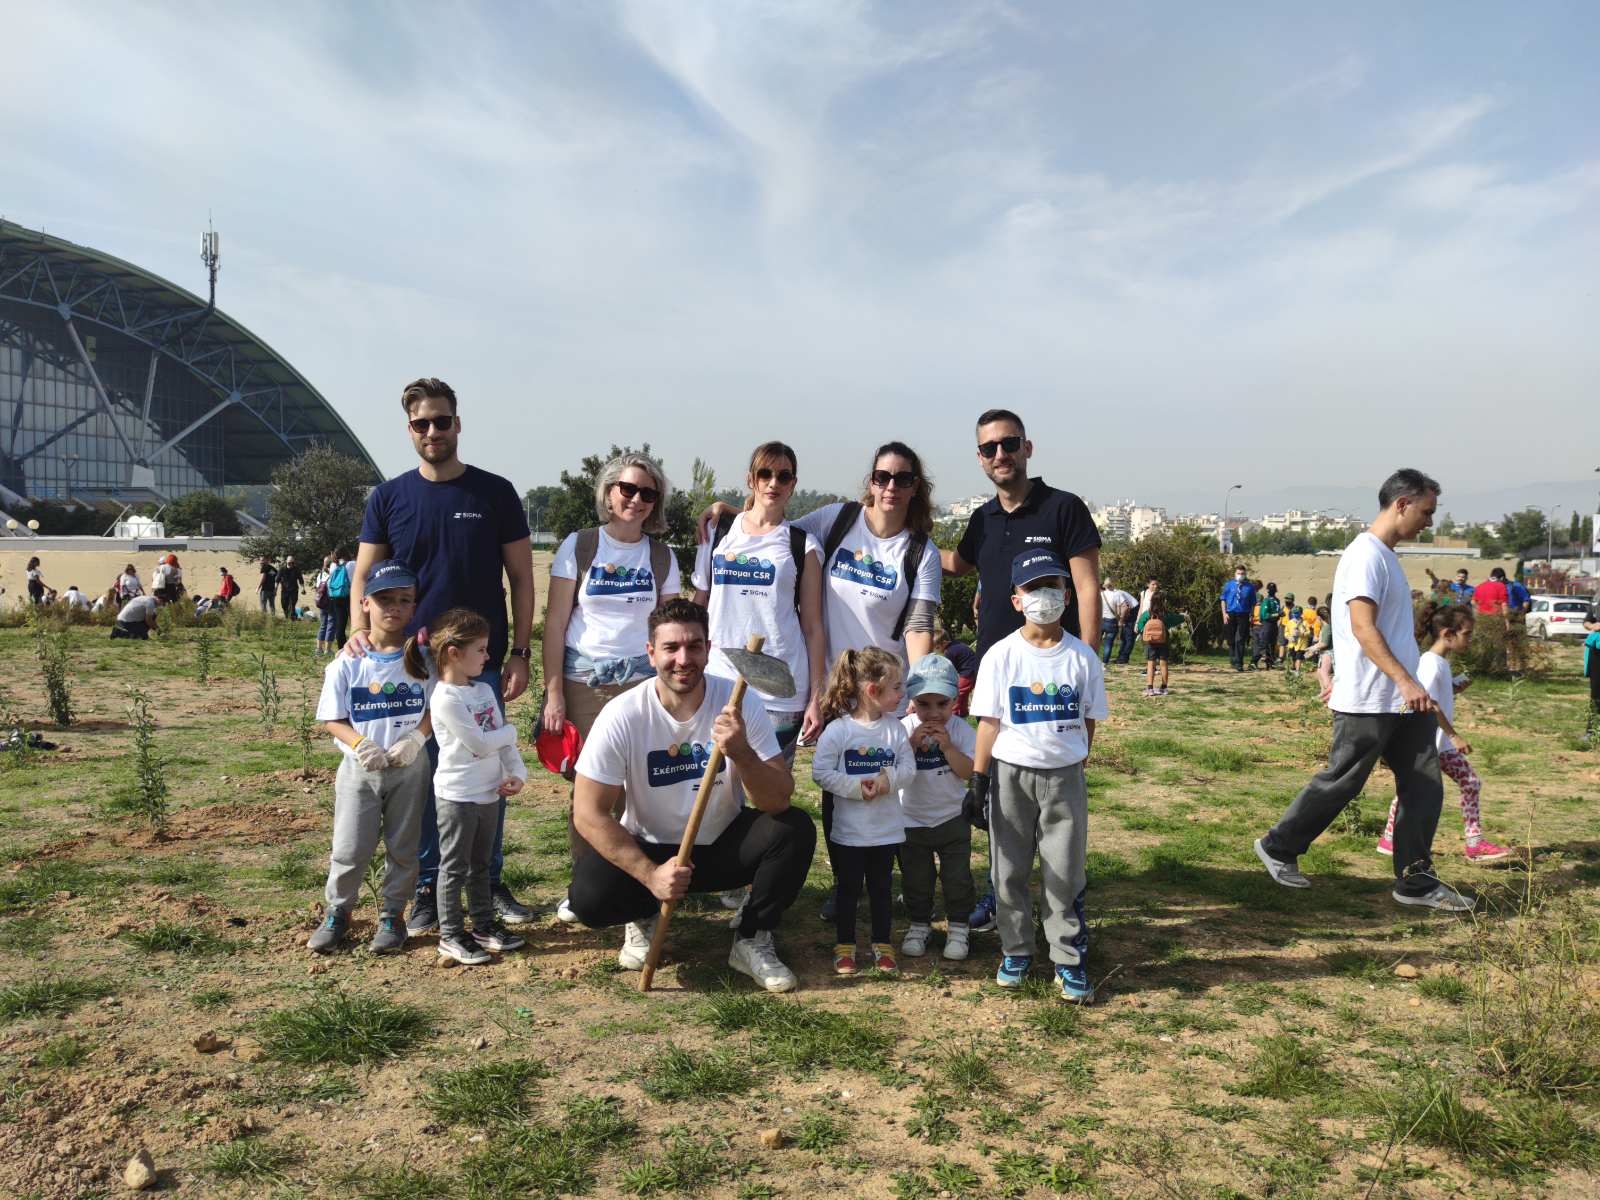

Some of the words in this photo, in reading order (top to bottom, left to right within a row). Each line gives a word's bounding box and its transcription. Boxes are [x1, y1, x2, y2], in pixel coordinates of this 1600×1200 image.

[1031, 555, 1053, 563] SIGMA
[753, 571, 770, 580] CSR
[875, 575, 892, 585] CSR
[749, 589, 768, 597] SIGMA
[353, 701, 404, 711] Σκέπτομαι
[405, 698, 423, 708] CSR
[1014, 702, 1065, 713] Σκέπτομαι
[652, 763, 698, 775] Σκέπτομαι
